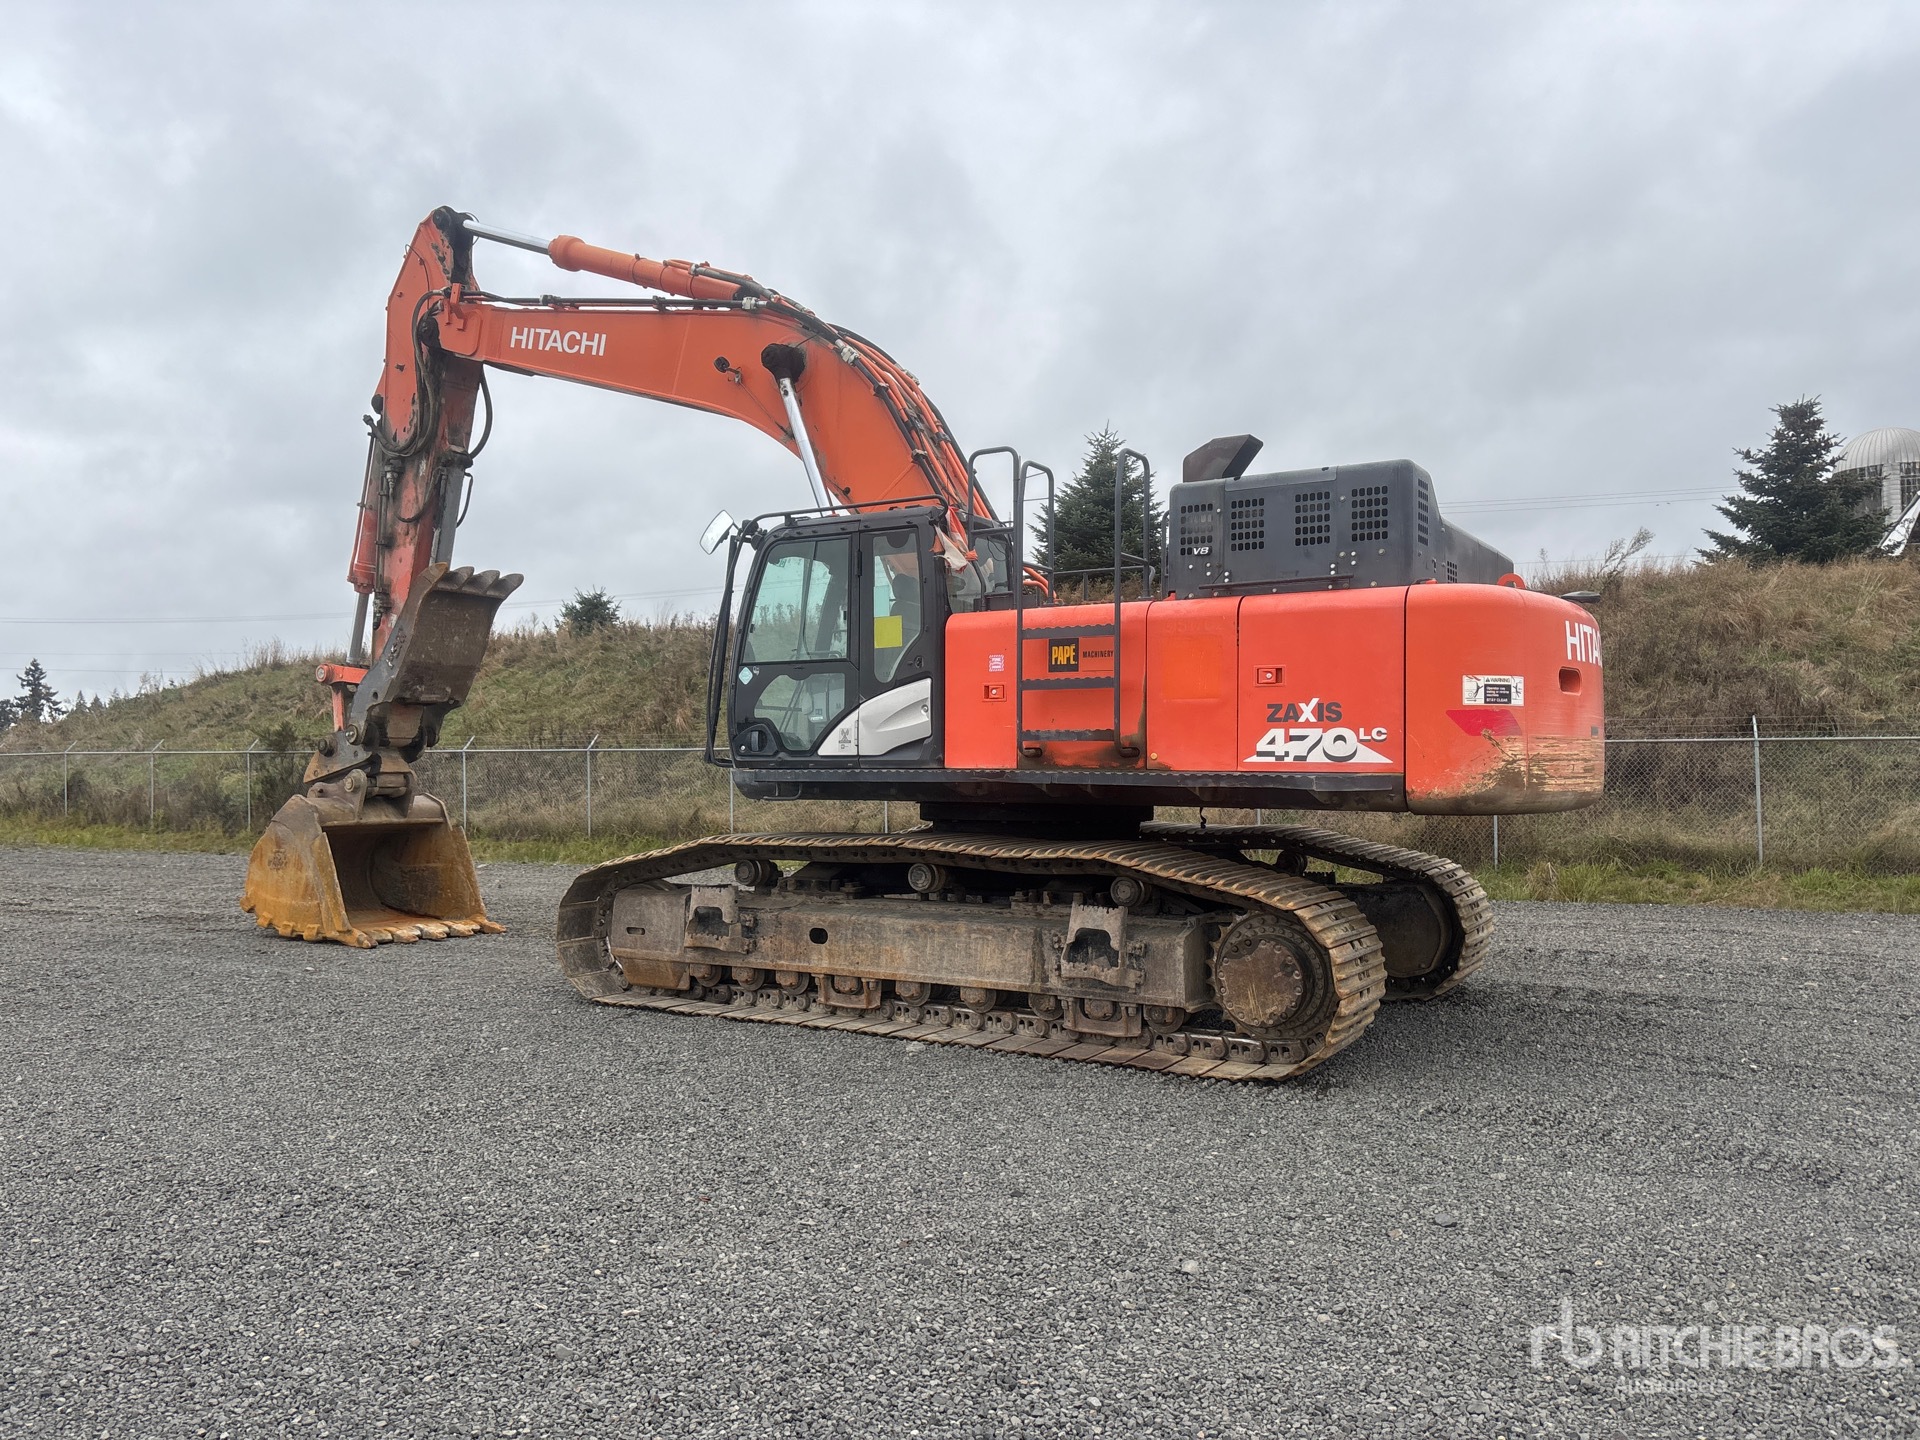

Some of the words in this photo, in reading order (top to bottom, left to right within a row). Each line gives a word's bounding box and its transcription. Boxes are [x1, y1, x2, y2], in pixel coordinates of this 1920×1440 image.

[510, 327, 606, 356] HITACHI
[1193, 546, 1209, 555] V8
[1082, 650, 1114, 658] MACHINERY
[1266, 698, 1343, 723] ZAXIS
[1359, 727, 1388, 742] LC
